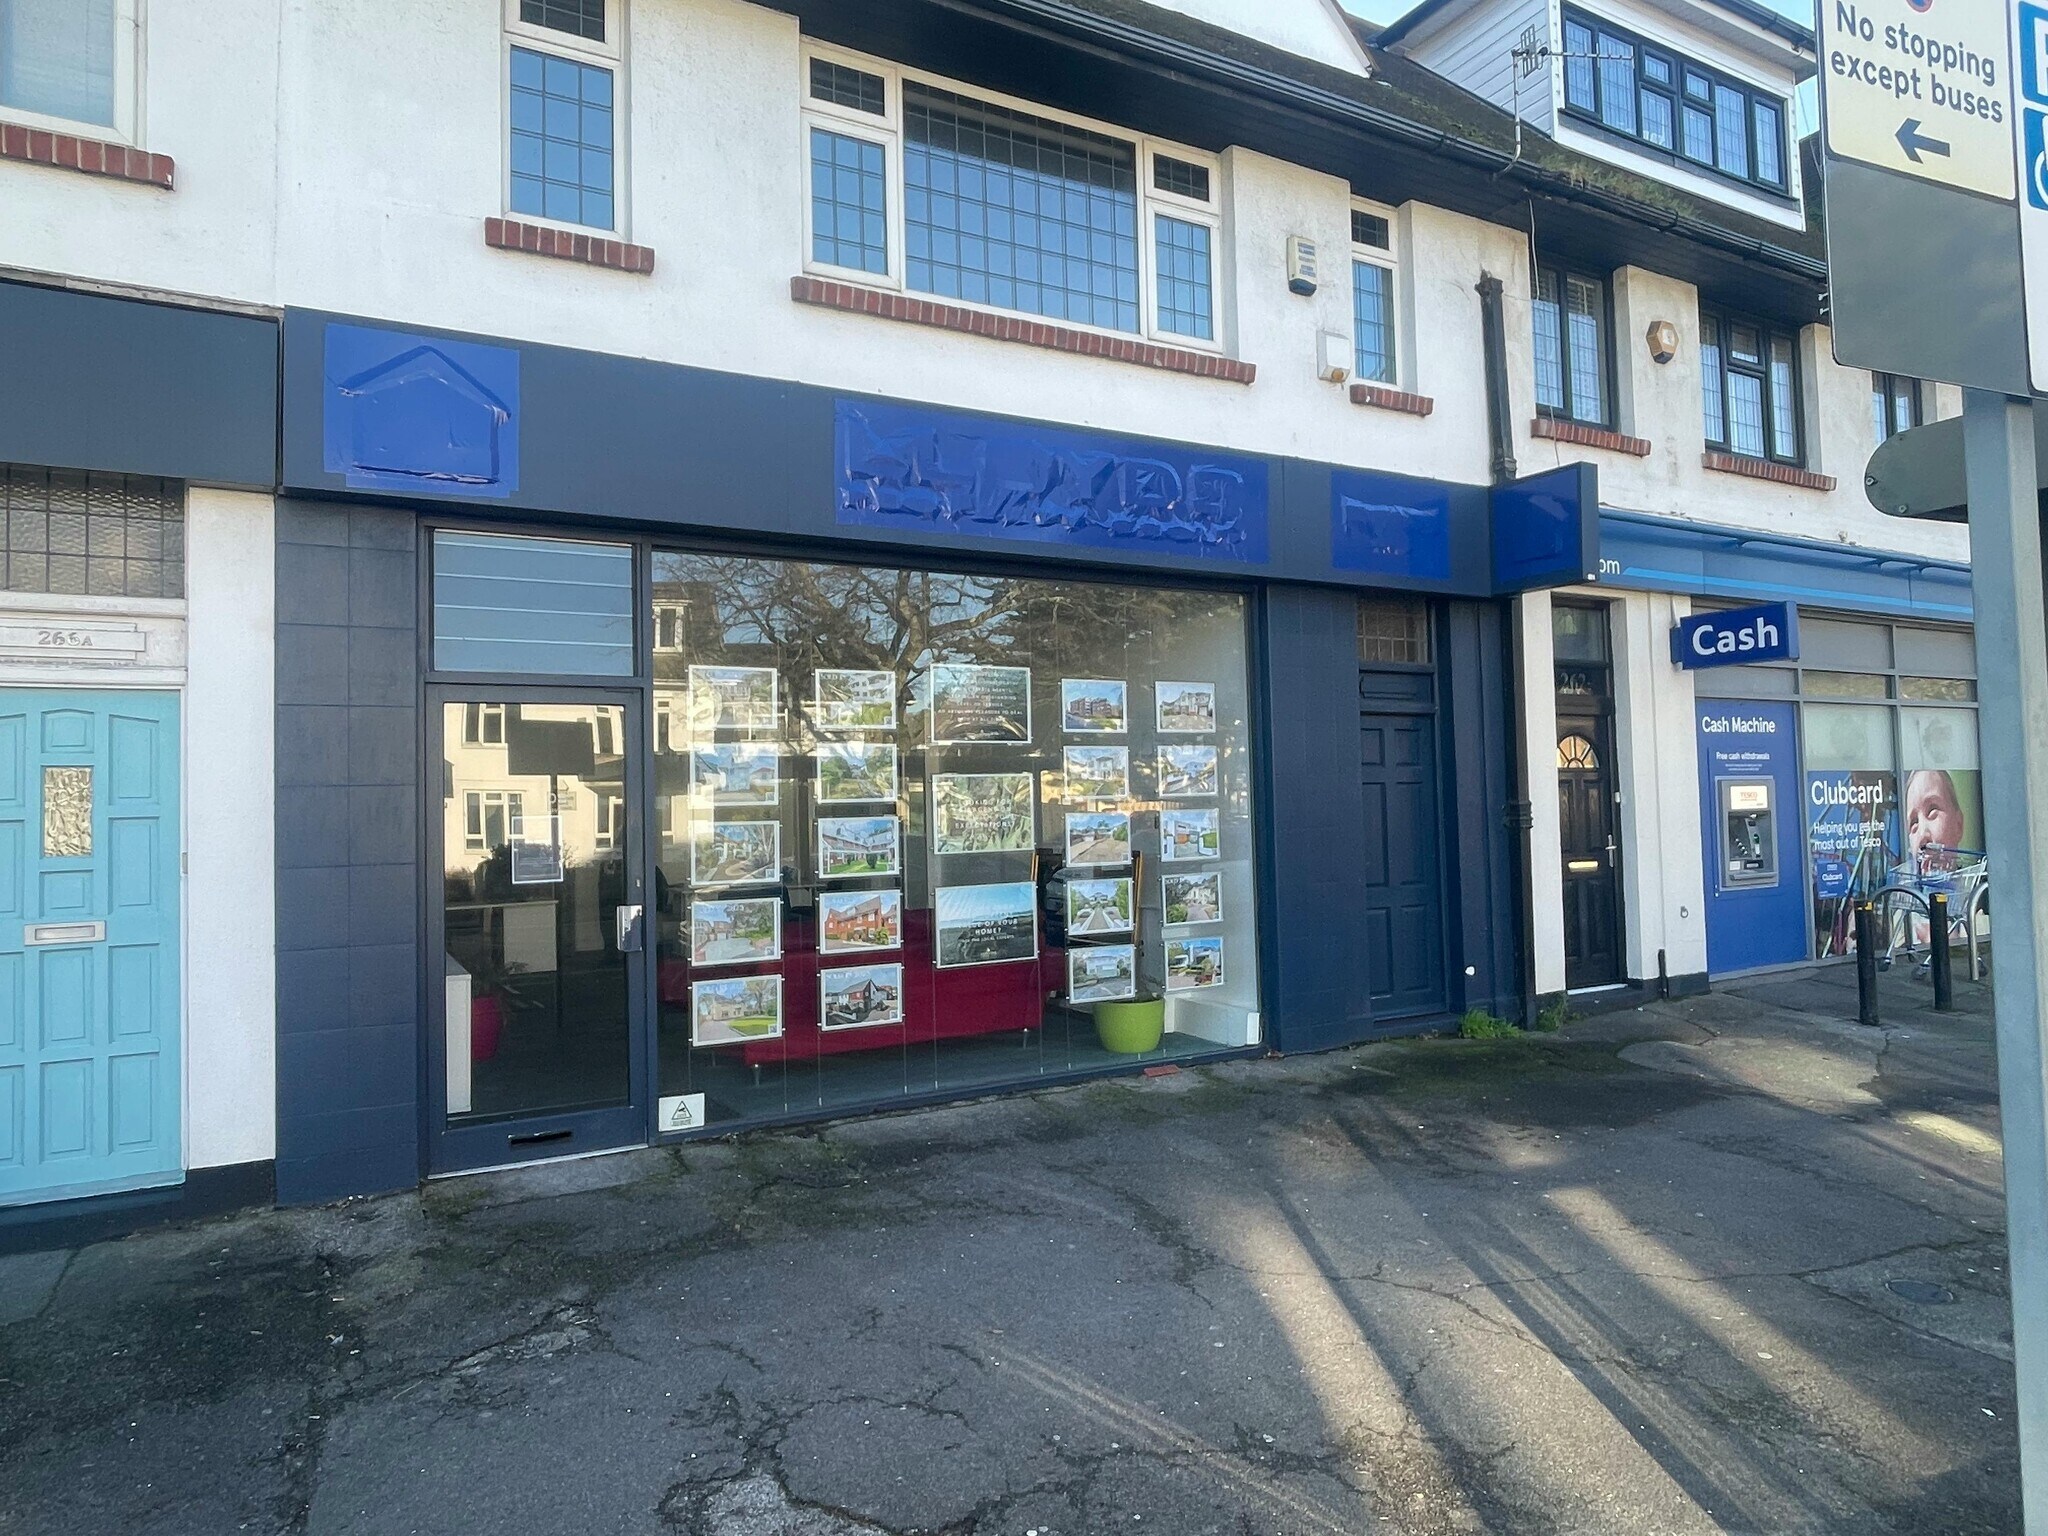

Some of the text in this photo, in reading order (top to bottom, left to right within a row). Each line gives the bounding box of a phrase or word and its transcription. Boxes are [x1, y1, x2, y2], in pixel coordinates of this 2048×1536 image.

[1836, 1, 1874, 42] No
[1885, 23, 1996, 87] stopping
[1831, 50, 2003, 123] except buses
[1692, 617, 1779, 656] Cash
[1702, 716, 1776, 733] Cash Machine
[1811, 779, 1883, 805] Clubcard
[1813, 819, 1885, 837] Helping you get the
[1814, 835, 1882, 851] most out of Tesco
